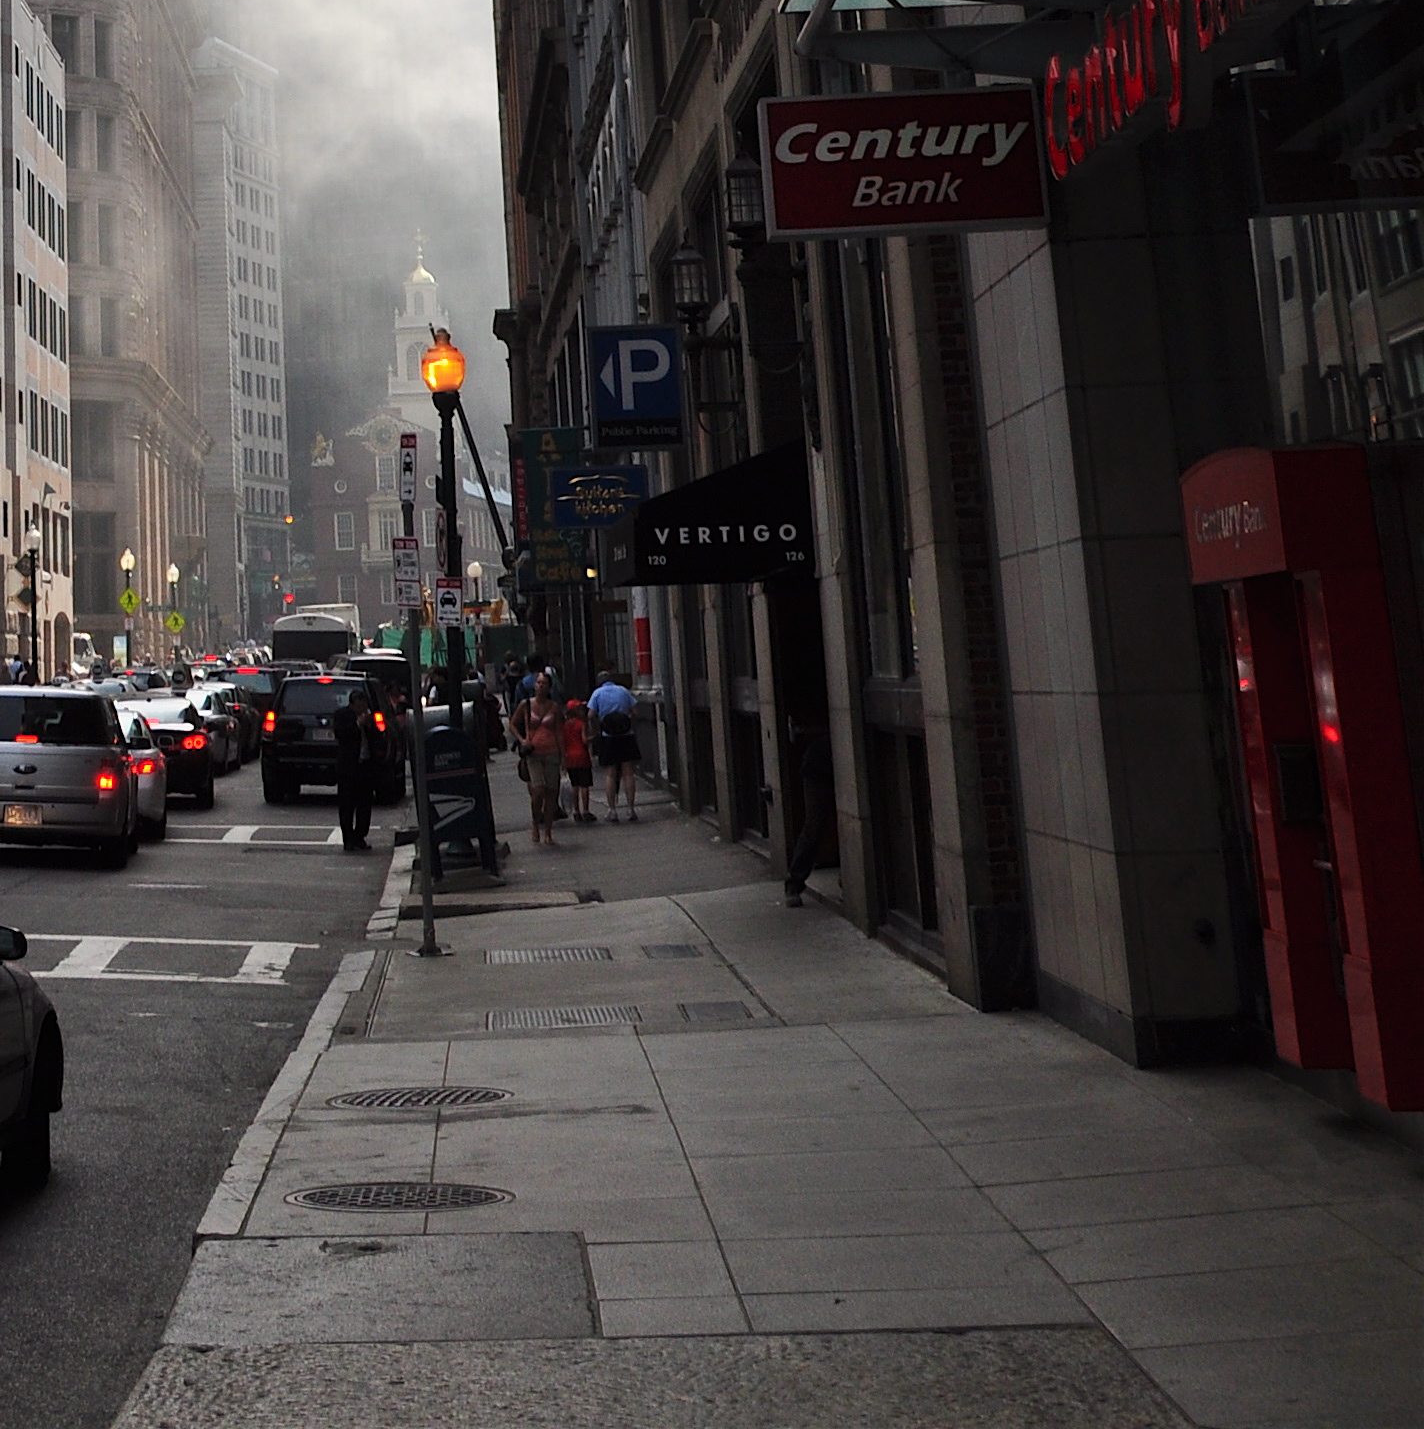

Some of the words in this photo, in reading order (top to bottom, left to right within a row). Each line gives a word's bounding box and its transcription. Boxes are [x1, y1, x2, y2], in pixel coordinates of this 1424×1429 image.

[775, 119, 1029, 166] Century
[852, 171, 964, 208] Bank
[618, 339, 671, 410] P
[654, 523, 797, 546] VERTIGO
[648, 555, 667, 566] 120
[785, 551, 805, 562] 126
